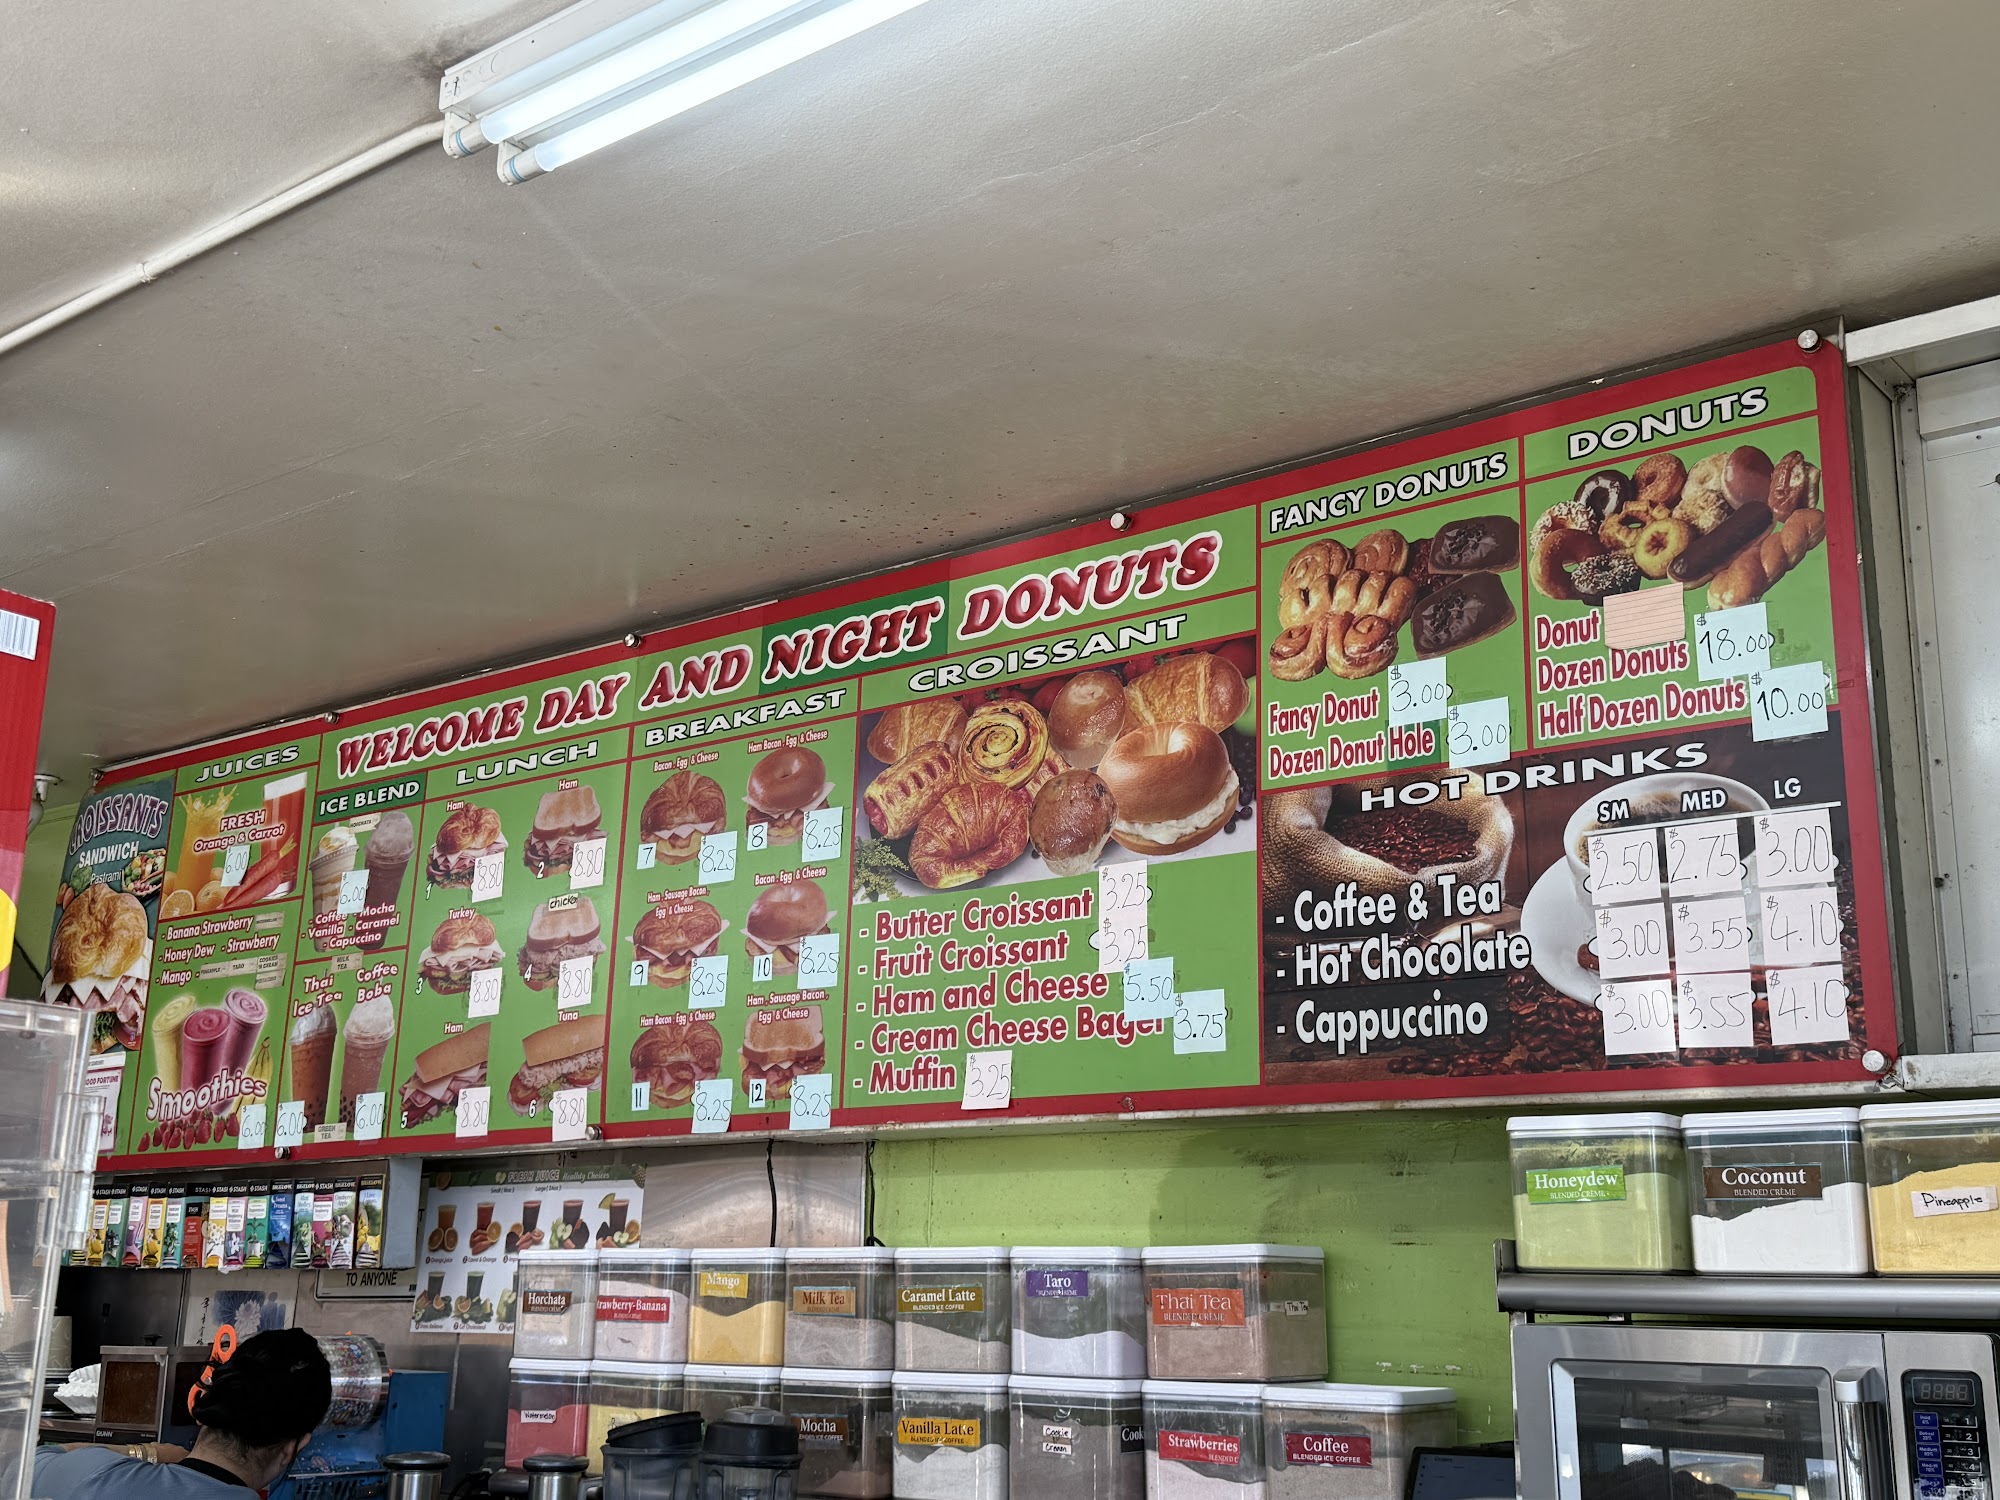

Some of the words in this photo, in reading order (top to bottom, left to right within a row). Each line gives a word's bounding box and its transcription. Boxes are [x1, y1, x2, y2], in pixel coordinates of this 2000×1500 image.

[1568, 386, 1768, 461] DONUTS
[1270, 486, 1368, 534] FANCY
[1374, 452, 1508, 508] DONUTS
[1535, 610, 1600, 650] Donut
[337, 695, 528, 780] WELCOME
[534, 672, 630, 733] DAY
[638, 644, 753, 711] AND
[761, 595, 944, 684] NIGHT
[957, 530, 1222, 640] DONUTS
[908, 614, 1187, 693] CROISSANT
[1537, 658, 1604, 694] Dozen
[1610, 640, 1689, 681] Donuts
[645, 688, 847, 747] BREAKFAST
[1268, 701, 1320, 740] Fancy
[1324, 687, 1379, 724] Donut
[1538, 696, 1584, 740] Half
[1588, 694, 1659, 732] Dozen
[1664, 678, 1746, 720] Donuts
[748, 742, 762, 754] Ham
[806, 729, 828, 740] Cheese
[1268, 745, 1325, 780] Dozen
[1329, 732, 1384, 769] Donut
[1388, 722, 1434, 760] Hole
[195, 746, 300, 782] JUICES
[456, 740, 599, 786] LUNCH
[696, 751, 719, 762] Cheese
[558, 778, 578, 792] Ham
[1360, 774, 1470, 814] HOT
[1484, 742, 1708, 796] DRINKS
[319, 797, 348, 816] ICE
[354, 782, 420, 809] BLEND
[446, 801, 464, 812] Ham
[1597, 800, 1630, 822] SM
[1681, 790, 1728, 813] MED
[1773, 776, 1802, 800] LG
[220, 809, 266, 832] FRESH
[194, 835, 235, 852] Orange
[237, 831, 246, 842] &
[248, 824, 286, 842] Carrot
[752, 825, 764, 848] 8
[78, 841, 140, 868] SANDWICH
[642, 846, 654, 865] 7
[90, 868, 122, 884] Pastrami
[802, 866, 827, 878] Cheese
[664, 889, 688, 901] Sausage
[1294, 880, 1397, 934] Coffee
[1407, 881, 1430, 922] &
[1437, 873, 1501, 918] Tea
[315, 911, 348, 924] Coffee
[360, 902, 395, 918] Mocha
[448, 906, 476, 921] Turkey
[674, 904, 694, 914] Cheese
[875, 907, 956, 943] Butter
[962, 888, 1093, 932] Croissant
[166, 924, 200, 941] Banana
[201, 914, 254, 936] Strawberry
[308, 924, 344, 940] Vanilla
[355, 912, 400, 932] Caramel
[164, 948, 193, 964] Honey
[194, 942, 216, 958] Dew
[226, 932, 280, 954] Strawberry
[330, 932, 382, 950] Capuccino
[874, 943, 933, 979] Fruit
[940, 930, 1069, 974] Croissant
[1294, 944, 1352, 986] Hot
[1360, 924, 1532, 982] Chocolate
[356, 961, 398, 983] Coffee
[524, 964, 532, 982] 4
[634, 964, 644, 984] 9
[756, 957, 770, 977] 10
[161, 969, 192, 986] Mango
[304, 974, 334, 994] Thai
[356, 982, 392, 1004] Boba
[769, 992, 800, 1005] Sausage
[872, 984, 935, 1018] Ham
[943, 971, 996, 1011] and
[1004, 968, 1109, 1007] Cheese
[292, 1000, 313, 1017] Ice
[316, 991, 342, 1007] Tea
[558, 1010, 580, 1022] Tuna
[694, 1010, 716, 1021] Cheese
[782, 1009, 808, 1020] Cheese
[1294, 987, 1489, 1055] Cappuccino
[444, 1022, 464, 1034] Ham
[870, 1020, 958, 1055] Cream
[966, 1012, 1068, 1050] Cheese
[869, 1056, 956, 1094] Muffin
[146, 1067, 267, 1122] Smoothies
[751, 1083, 763, 1103] 12
[528, 1099, 537, 1118] 6
[400, 1111, 408, 1130] 5
[1534, 1171, 1618, 1192] Honeydew
[1722, 1168, 1806, 1185] Coconut
[1550, 1190, 1580, 1200] BLENDED
[1734, 1188, 1768, 1196] BLENDED
[1921, 1192, 1983, 1210] Pineapple
[346, 1272, 358, 1286] TO
[360, 1272, 398, 1286] ANYONE
[706, 1272, 740, 1288] Mango
[1044, 1273, 1072, 1288] Taro
[528, 1292, 566, 1306] Horchata
[597, 1298, 667, 1313] trawberry-Banana
[802, 1290, 825, 1305] Milk
[828, 1292, 845, 1305] Tea
[902, 1288, 946, 1303] Caramel
[949, 1289, 976, 1302] Latte
[1156, 1294, 1194, 1310] Thai
[1200, 1294, 1231, 1310] Tea
[1164, 1312, 1196, 1321] BLENDED
[800, 1418, 836, 1432] Mocha
[902, 1420, 940, 1435] Vanilla
[944, 1421, 974, 1436] Latte
[1046, 1428, 1068, 1436] Cookie
[1168, 1434, 1238, 1452] Strawberries
[1302, 1436, 1349, 1454] Coffee
[1293, 1453, 1322, 1462] BLENDED
[1336, 1455, 1360, 1464] COFFEE
